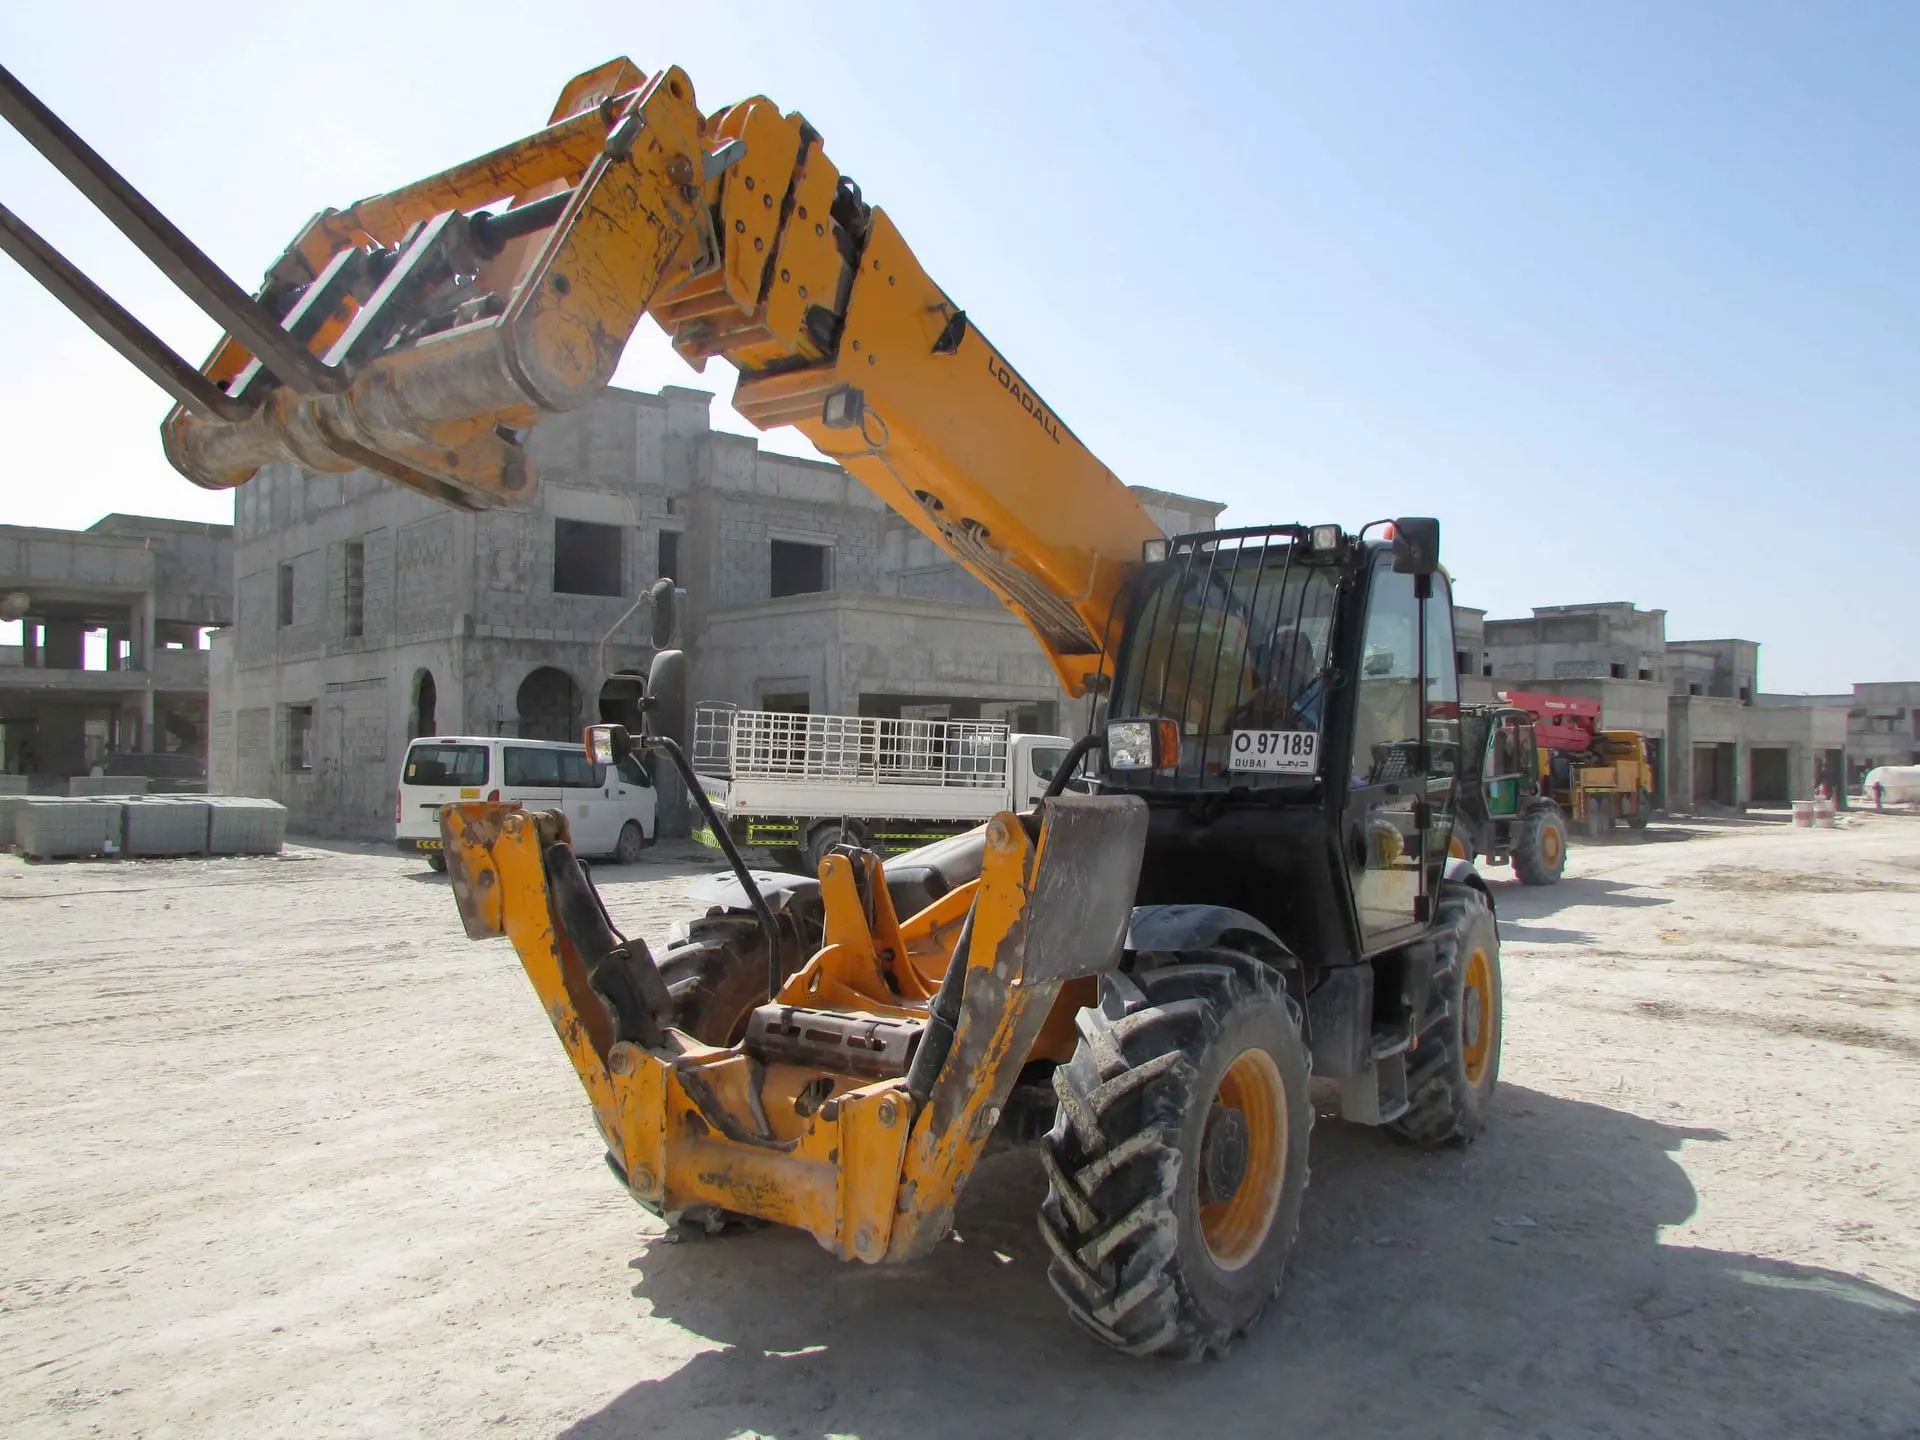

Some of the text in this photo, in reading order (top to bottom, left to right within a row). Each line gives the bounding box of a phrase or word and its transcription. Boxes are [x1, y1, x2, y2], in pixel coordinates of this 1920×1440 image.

[988, 355, 1060, 445] LOADALL
[1257, 733, 1314, 755] 97189
[1235, 758, 1266, 768] DUBAI
